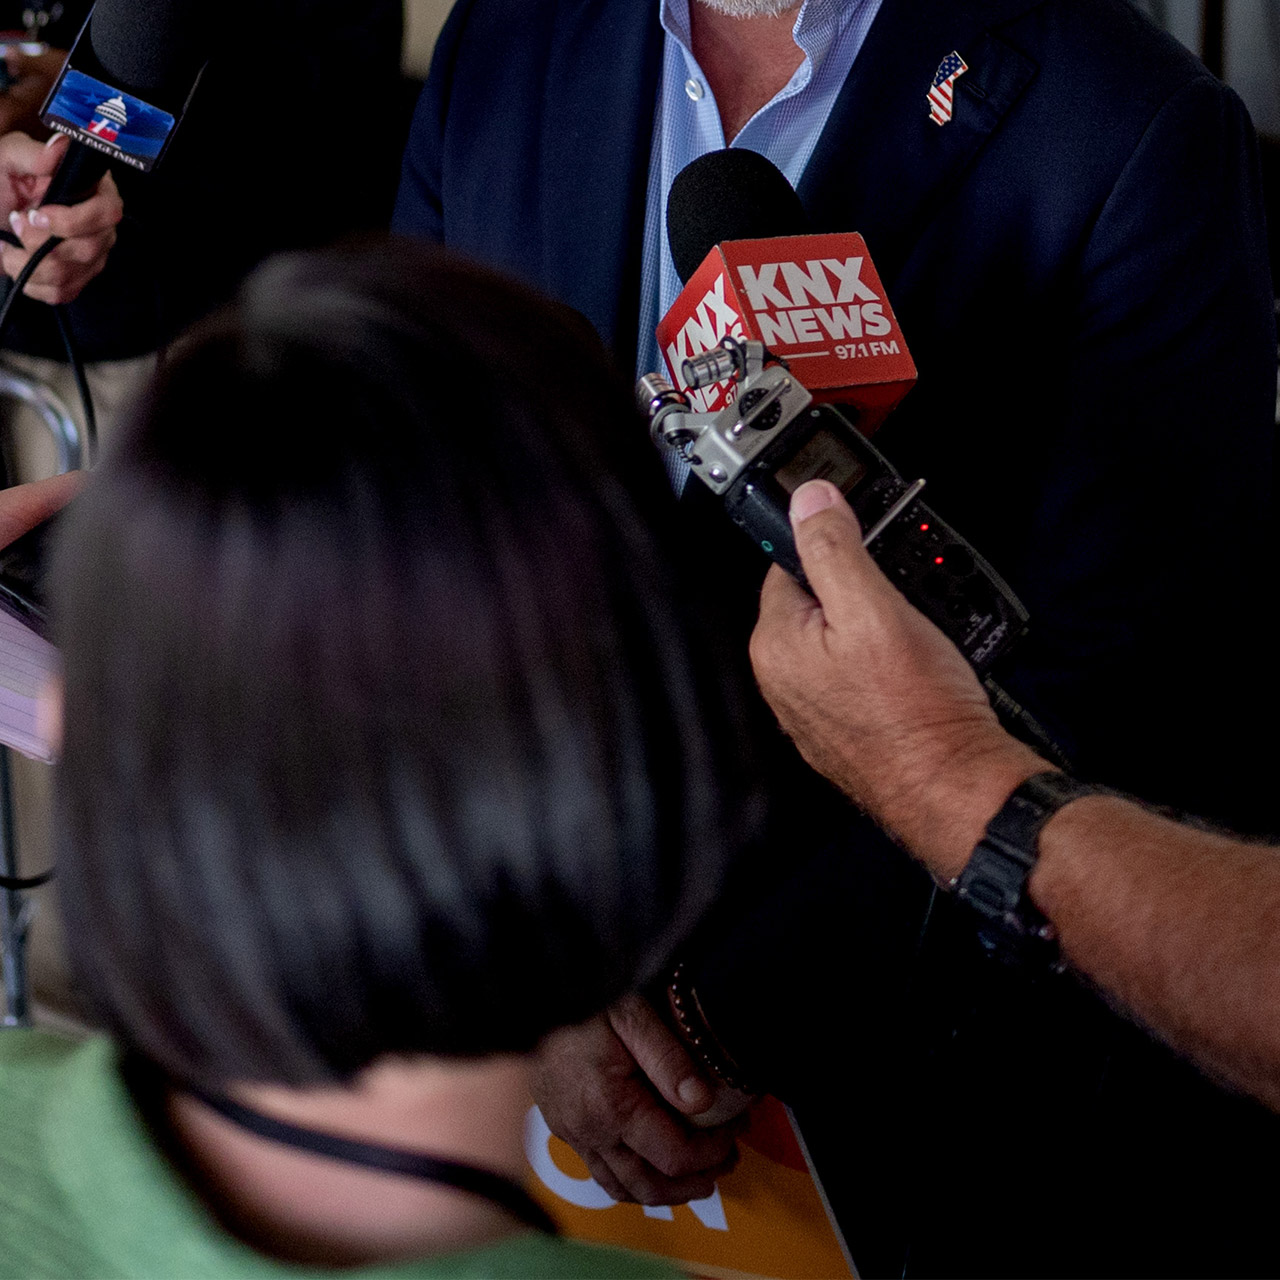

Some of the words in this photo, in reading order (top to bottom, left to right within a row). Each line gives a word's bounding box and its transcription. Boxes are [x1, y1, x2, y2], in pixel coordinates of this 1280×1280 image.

[50, 121, 86, 141] FRONT
[85, 138, 113, 156] PAGE
[113, 150, 146, 170] INDEX
[737, 257, 880, 310] KNX
[666, 272, 739, 392] KNX
[755, 303, 891, 347] NEWS
